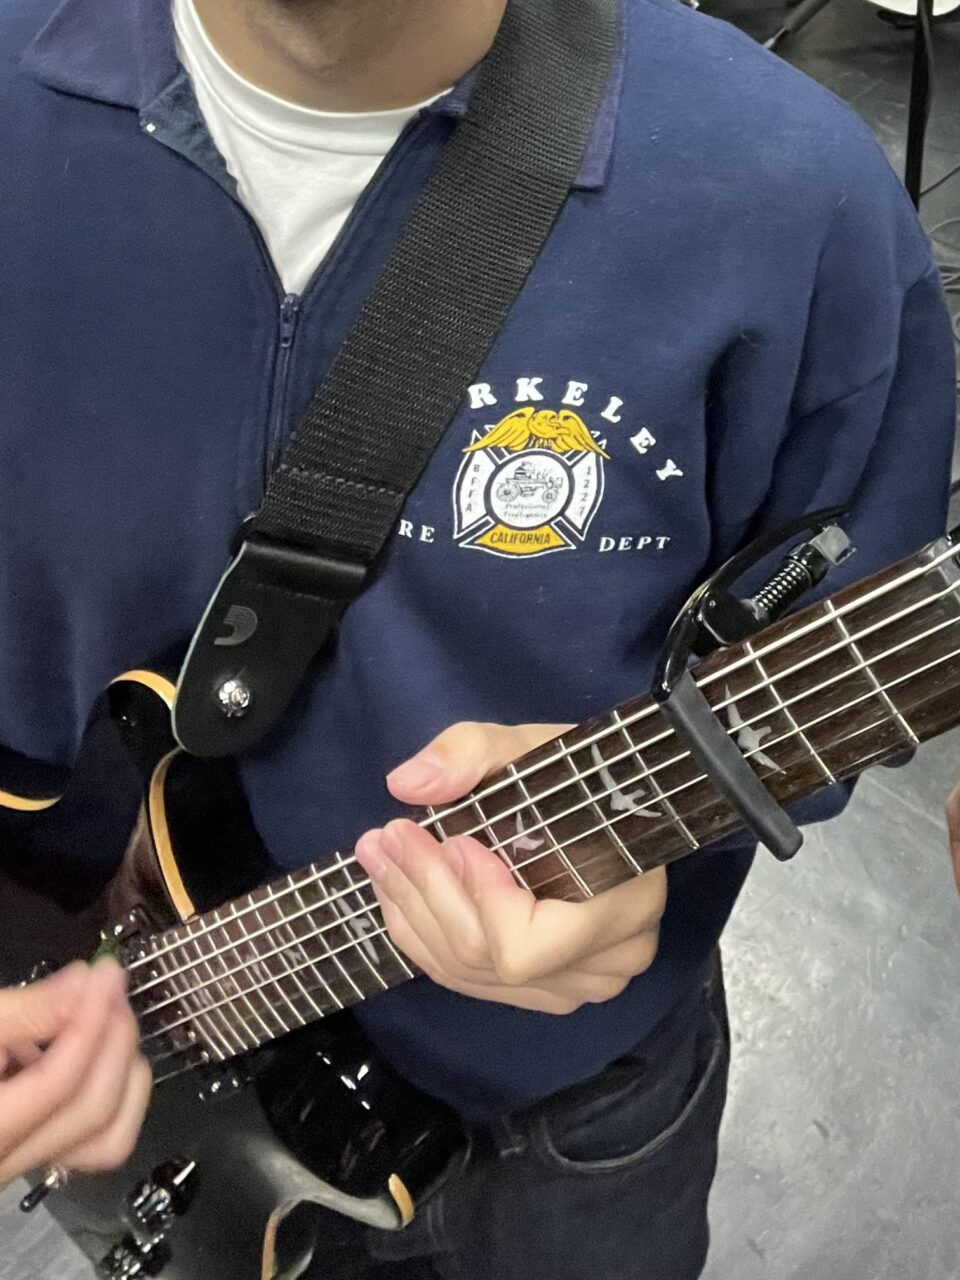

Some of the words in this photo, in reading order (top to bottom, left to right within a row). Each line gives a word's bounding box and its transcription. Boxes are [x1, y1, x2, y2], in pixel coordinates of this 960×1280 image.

[467, 377, 684, 481] RKELEY
[399, 519, 435, 543] RE
[599, 536, 671, 552] DEPT
[489, 531, 551, 545] CALIFORNIA
